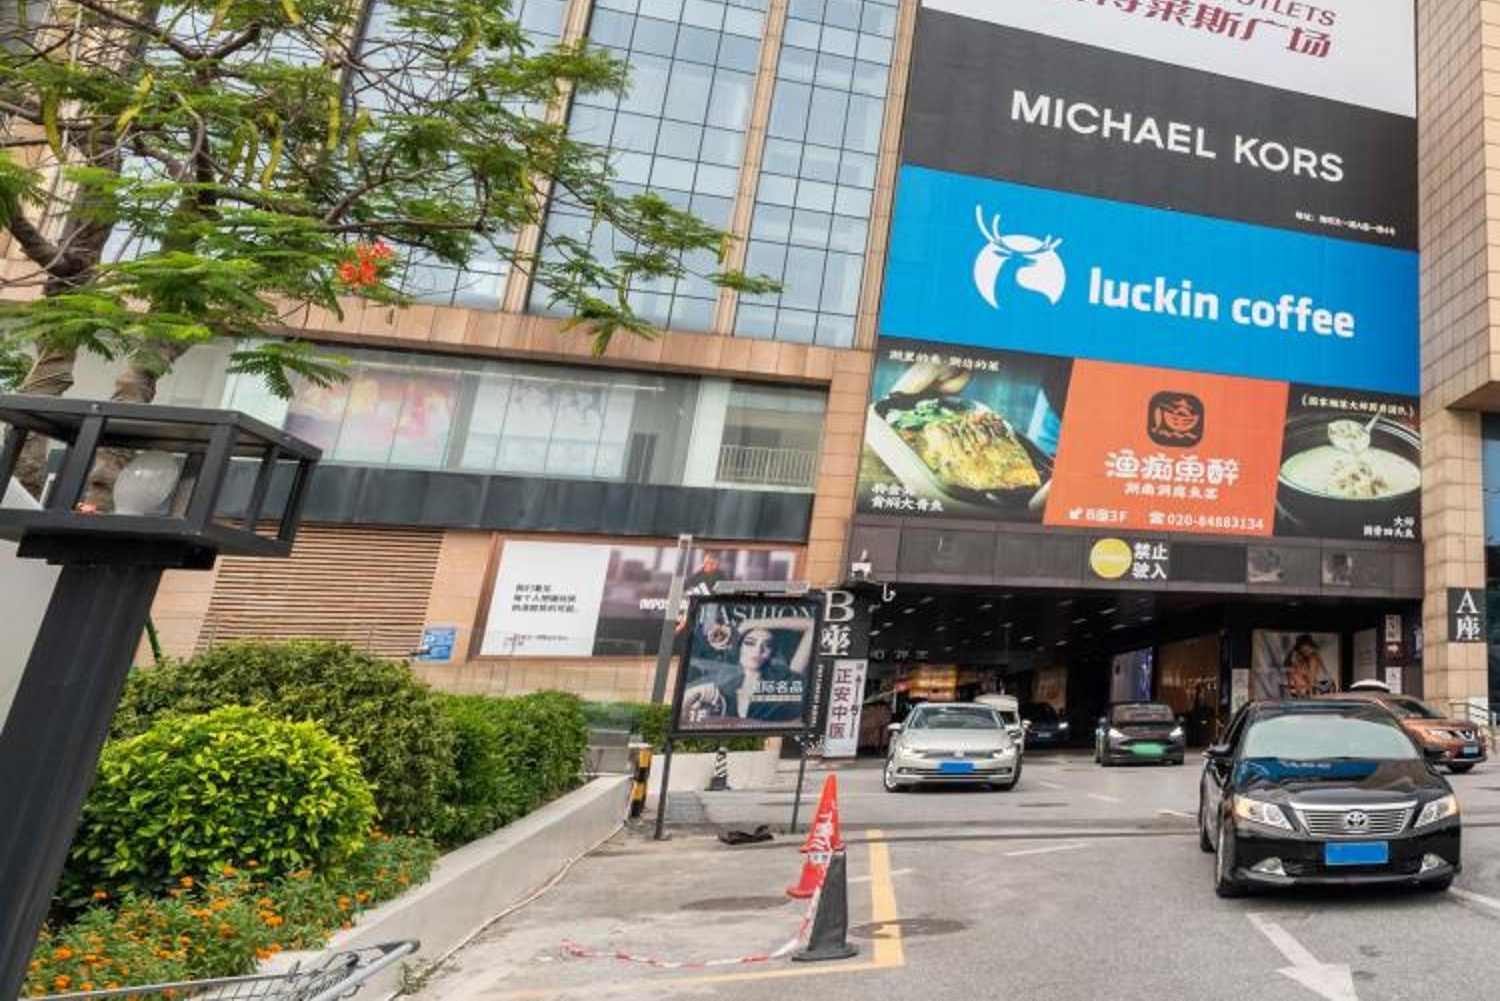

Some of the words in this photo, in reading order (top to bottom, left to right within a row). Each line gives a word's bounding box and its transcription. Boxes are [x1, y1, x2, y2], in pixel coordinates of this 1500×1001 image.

[1010, 89, 1217, 160] MICHAEL
[1233, 134, 1345, 183] KORS
[1088, 266, 1219, 322] luckin
[1231, 293, 1355, 339] coffee
[1134, 542, 1168, 560] 禁止
[1456, 589, 1481, 641] A座
[832, 668, 853, 739] 正安中医
